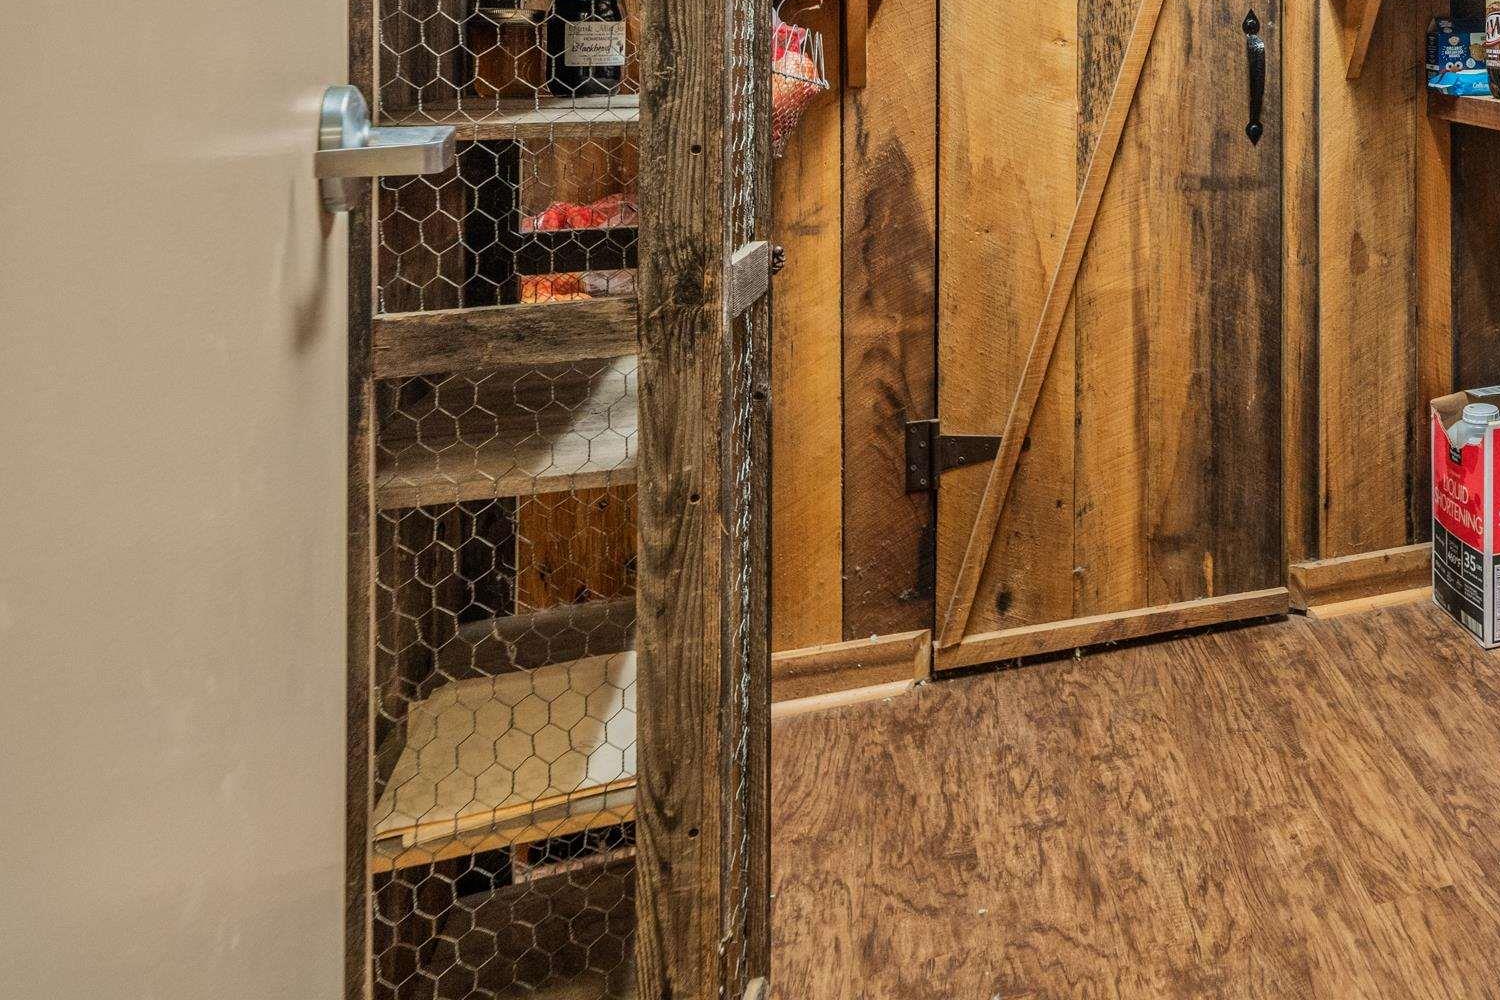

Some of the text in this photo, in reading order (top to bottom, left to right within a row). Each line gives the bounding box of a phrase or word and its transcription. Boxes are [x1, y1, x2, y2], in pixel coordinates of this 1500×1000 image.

[1443, 475, 1469, 505] LIQUID
[1434, 485, 1484, 536] SHORTENING
[1463, 551, 1477, 572] 35
